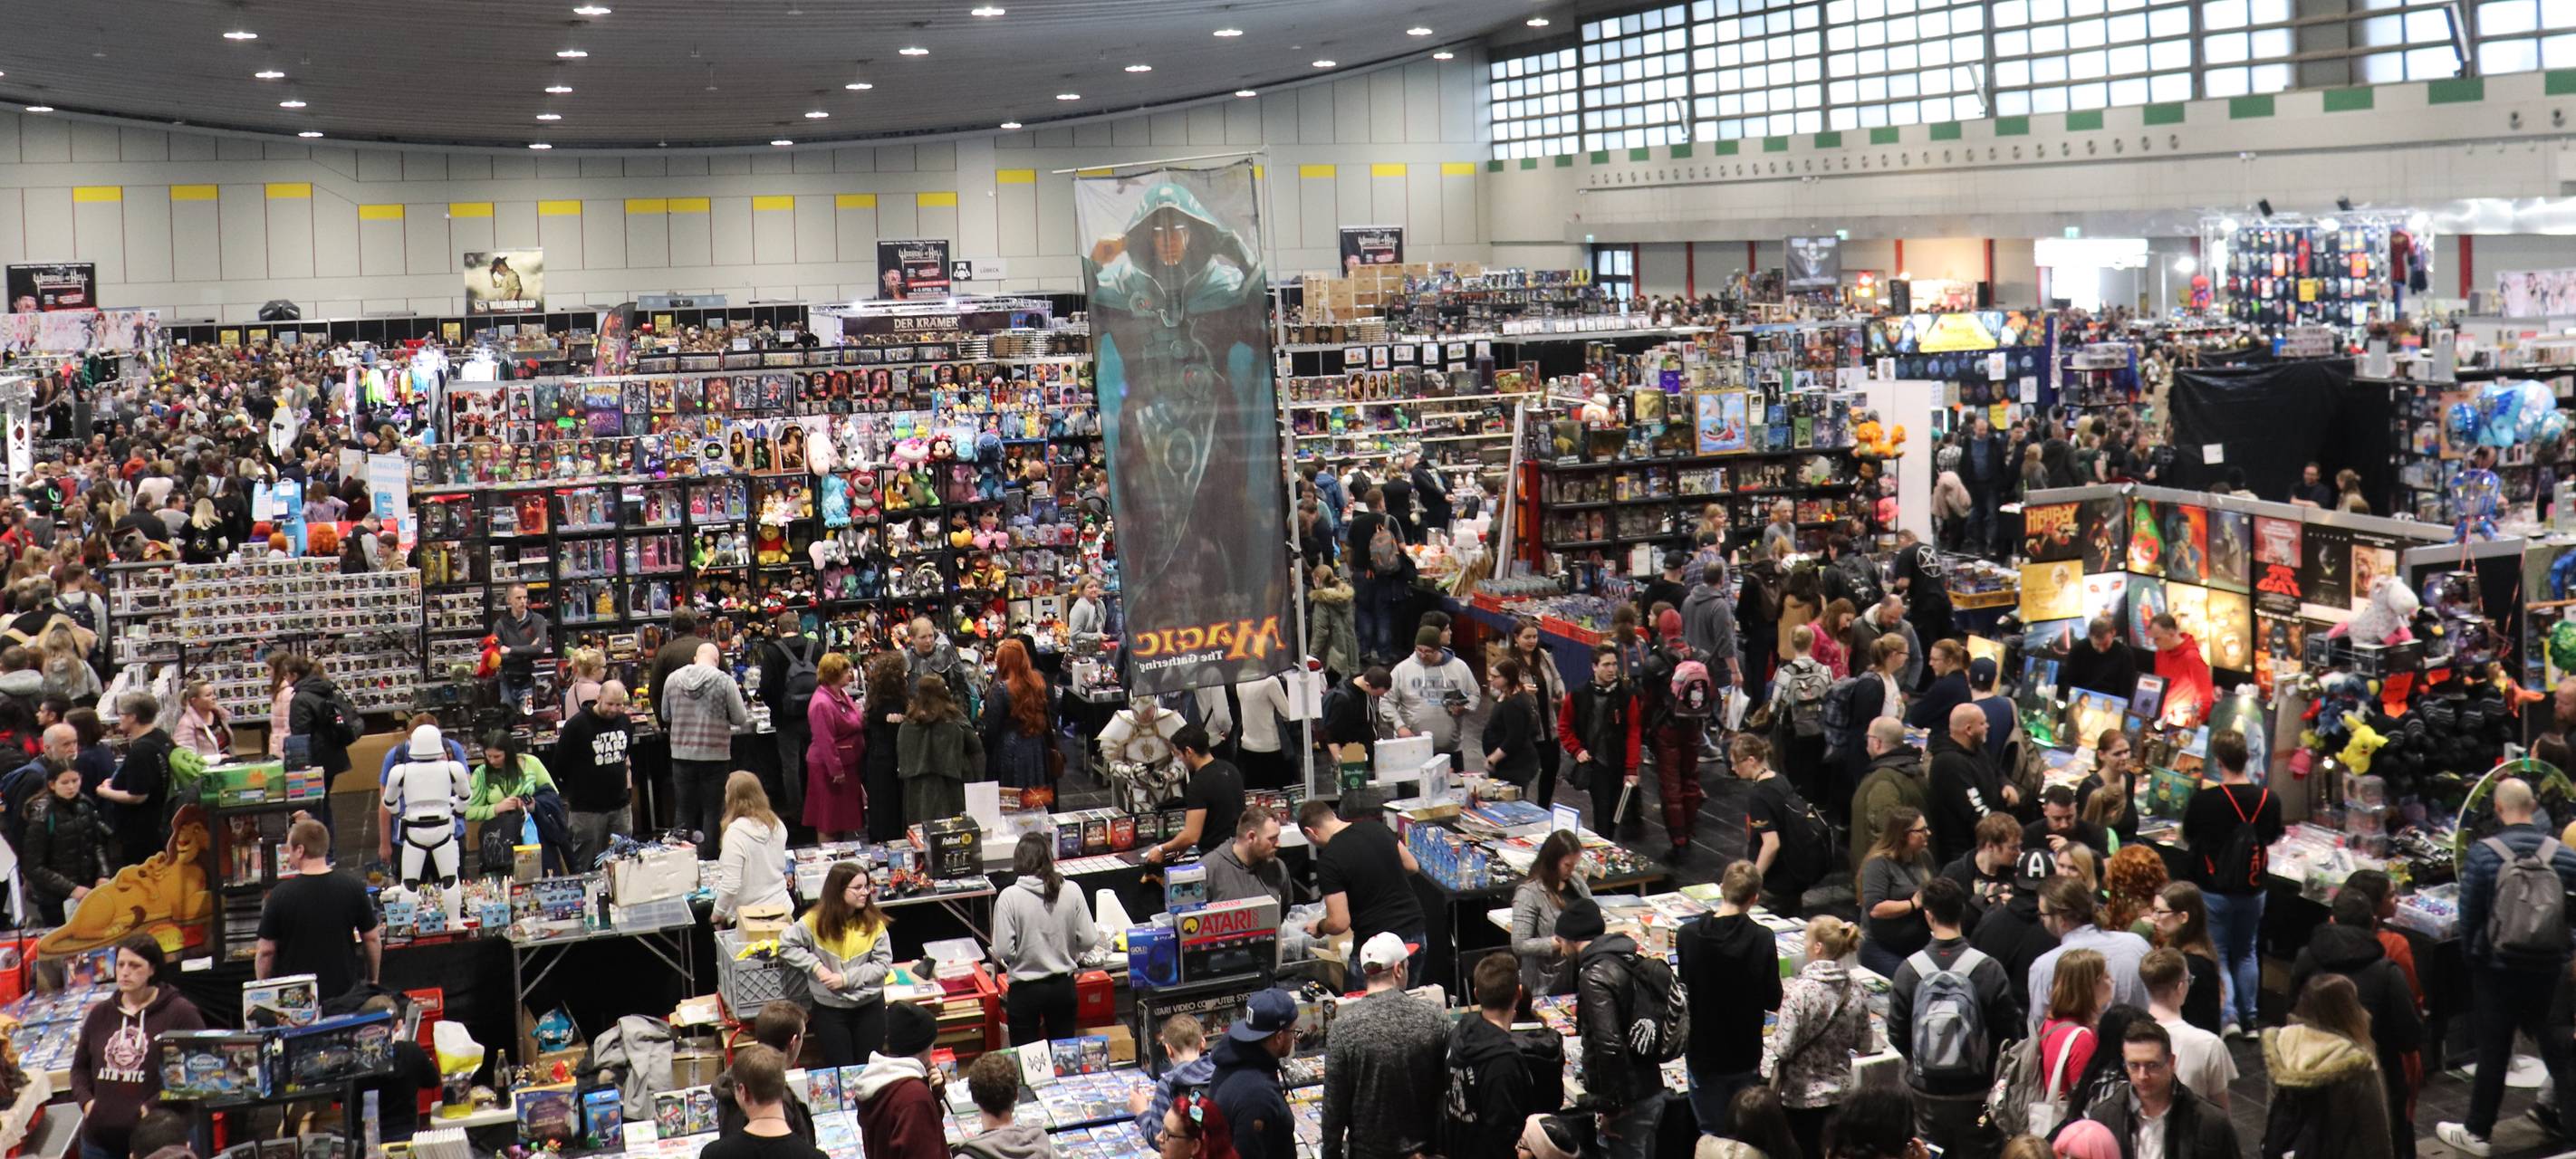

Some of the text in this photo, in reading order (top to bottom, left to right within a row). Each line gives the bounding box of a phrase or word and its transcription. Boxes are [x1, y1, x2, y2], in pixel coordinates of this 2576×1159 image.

[894, 316, 958, 329] DER KRÄMER
[1199, 908, 1251, 935] ATARI
[1173, 1001, 1197, 1014] VIDEO
